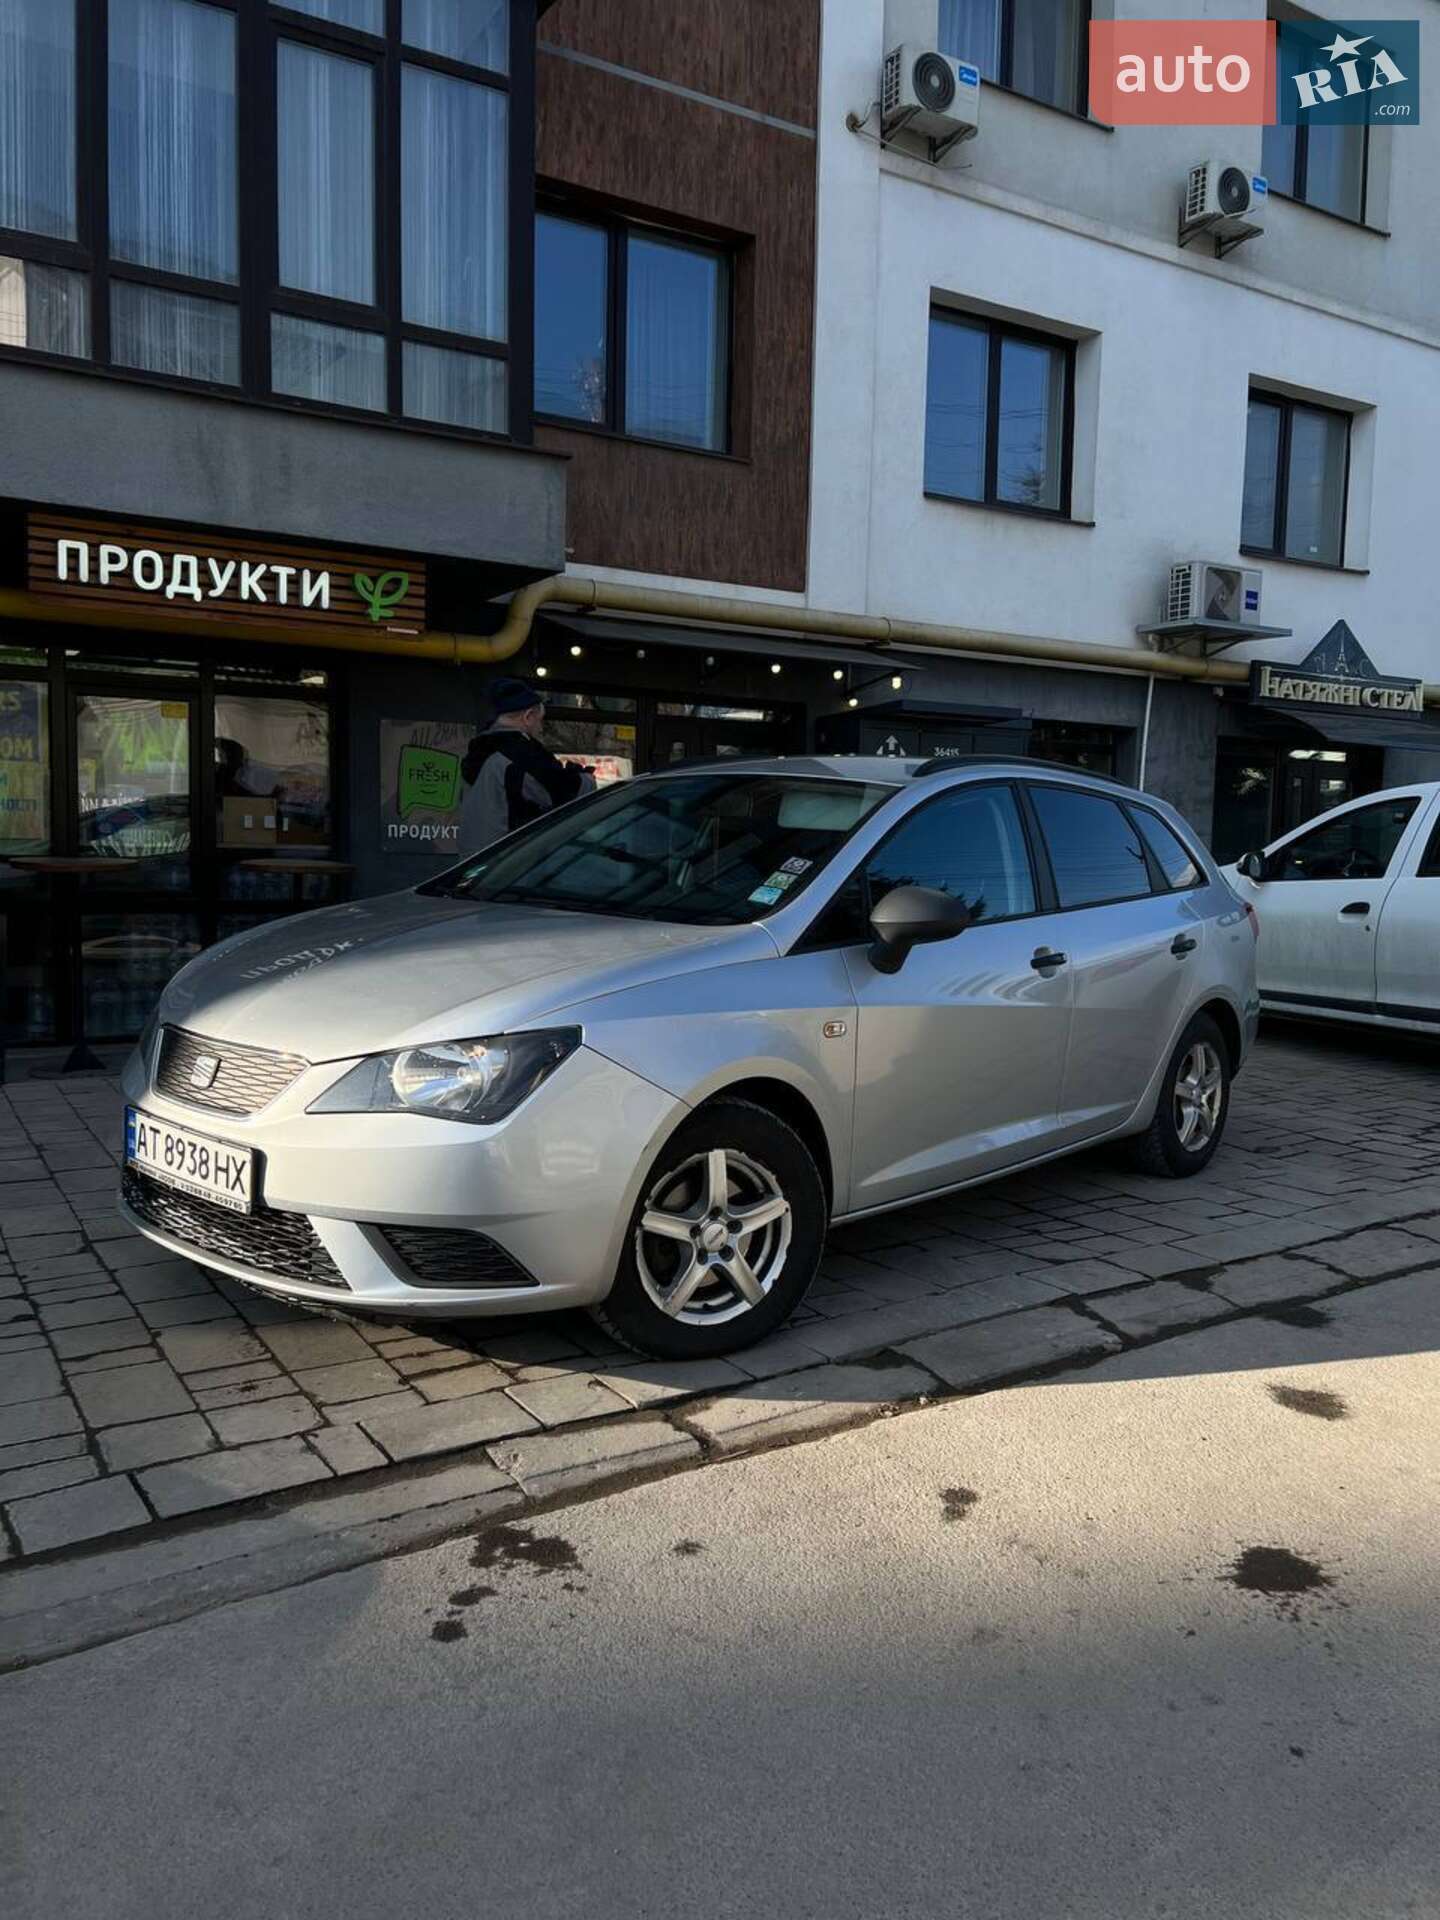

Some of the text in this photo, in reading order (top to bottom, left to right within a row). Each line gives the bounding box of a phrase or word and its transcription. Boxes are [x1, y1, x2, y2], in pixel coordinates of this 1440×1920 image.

[57, 539, 331, 609] ПРОДУКТИ
[408, 768, 450, 783] FRESH
[388, 824, 459, 840] ПРОДУКТ
[138, 1123, 161, 1160] AT
[165, 1133, 210, 1180] 8938
[214, 1150, 246, 1195] HX
